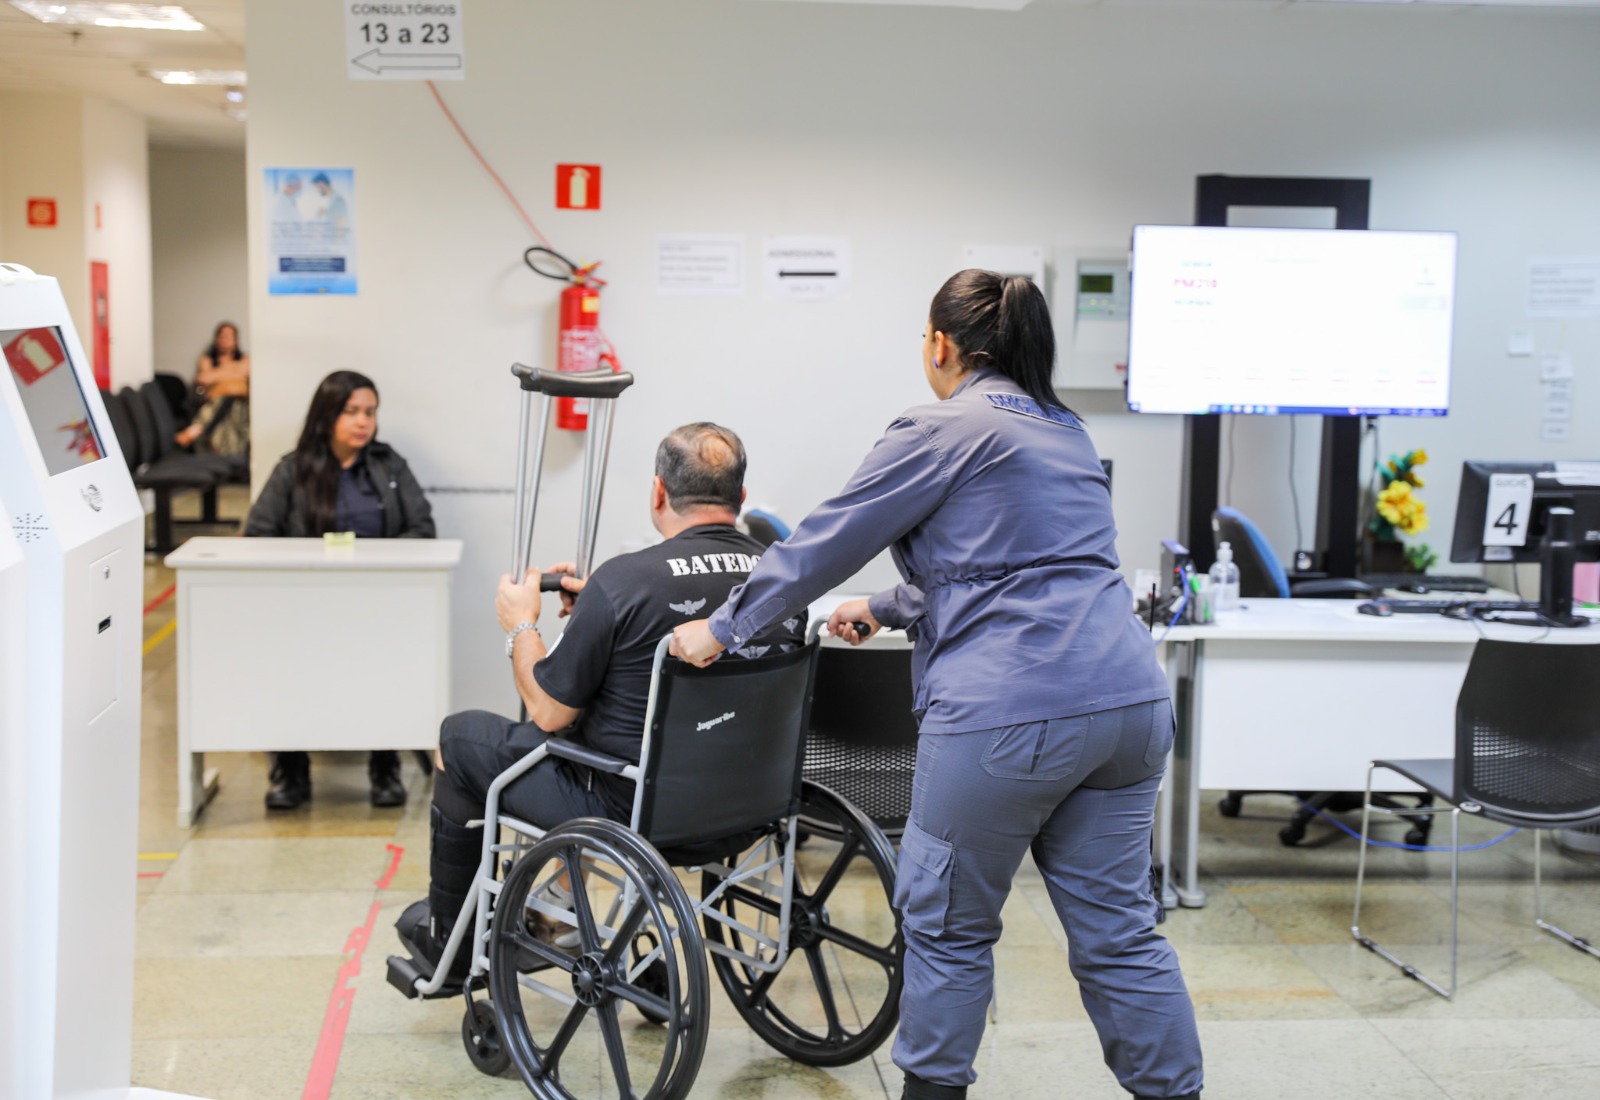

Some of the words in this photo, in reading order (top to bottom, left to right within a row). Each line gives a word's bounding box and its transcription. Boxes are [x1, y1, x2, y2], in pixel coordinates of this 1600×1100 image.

[351, 3, 457, 16] CONSULTÓRIOS
[360, 23, 389, 43] 13
[398, 28, 412, 43] a
[421, 23, 450, 43] 23
[1493, 503, 1518, 536] 4
